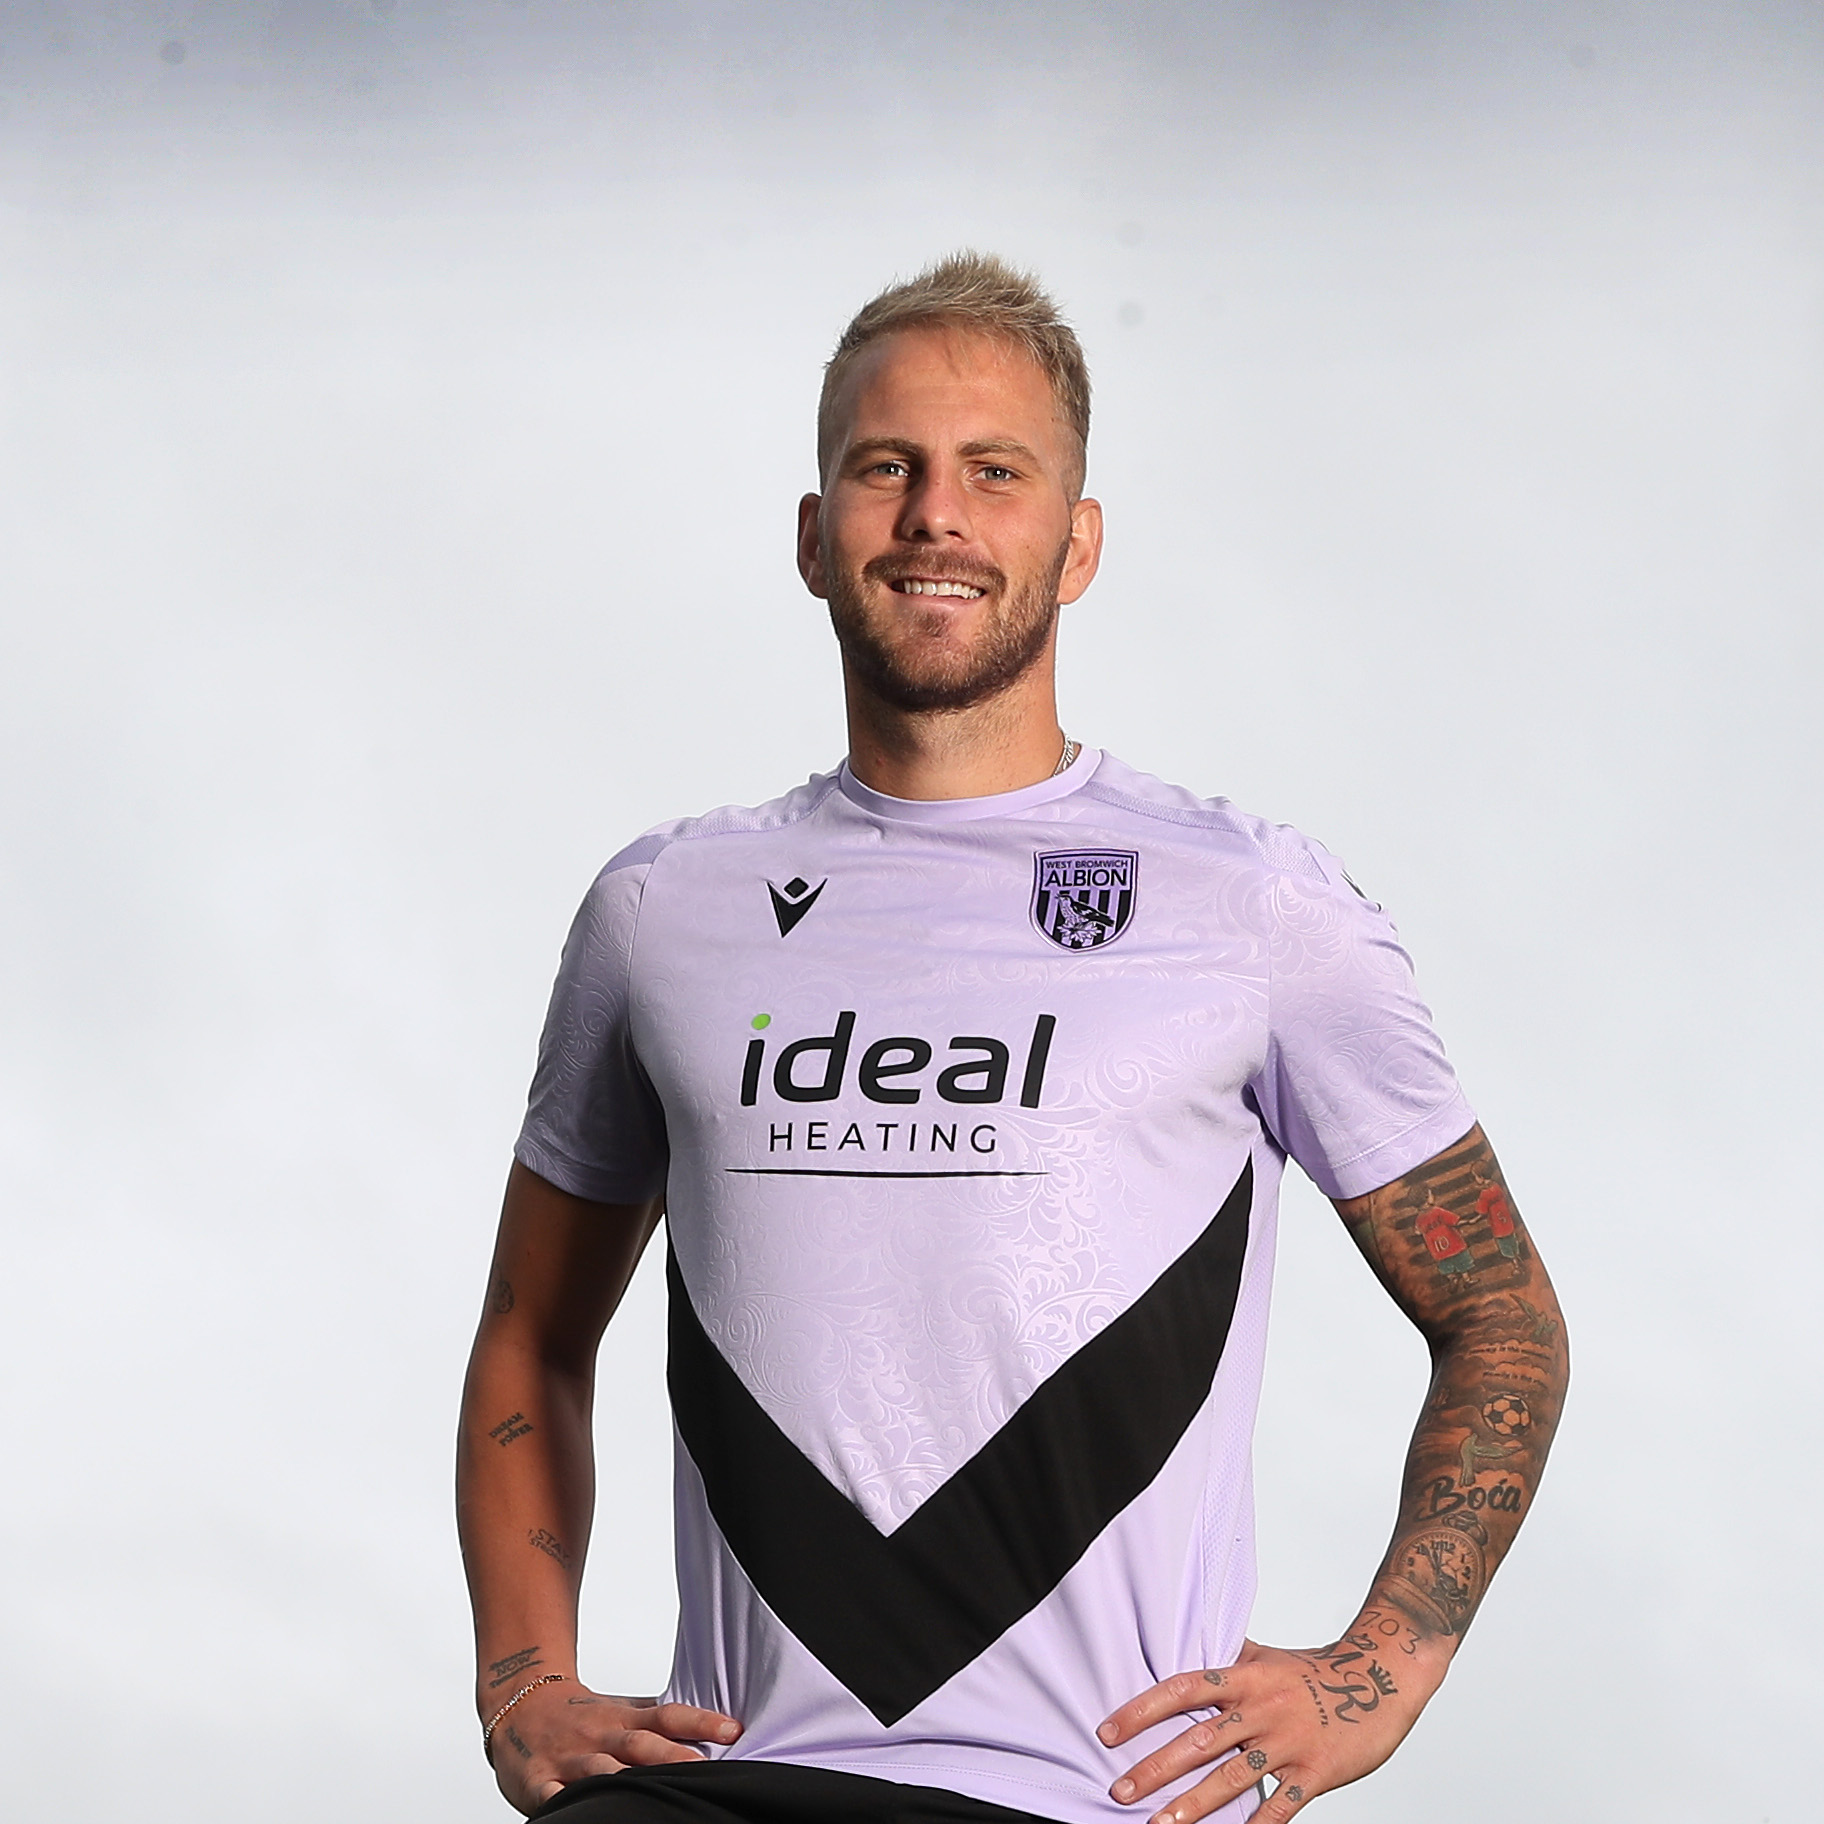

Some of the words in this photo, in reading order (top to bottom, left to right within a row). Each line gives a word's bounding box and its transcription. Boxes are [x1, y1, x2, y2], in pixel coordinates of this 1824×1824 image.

[1045, 860, 1072, 869] WEST
[1075, 859, 1128, 869] BROMWICH
[1045, 868, 1127, 887] ALBION
[740, 1011, 1058, 1109] ideal
[768, 1122, 999, 1153] HEATING
